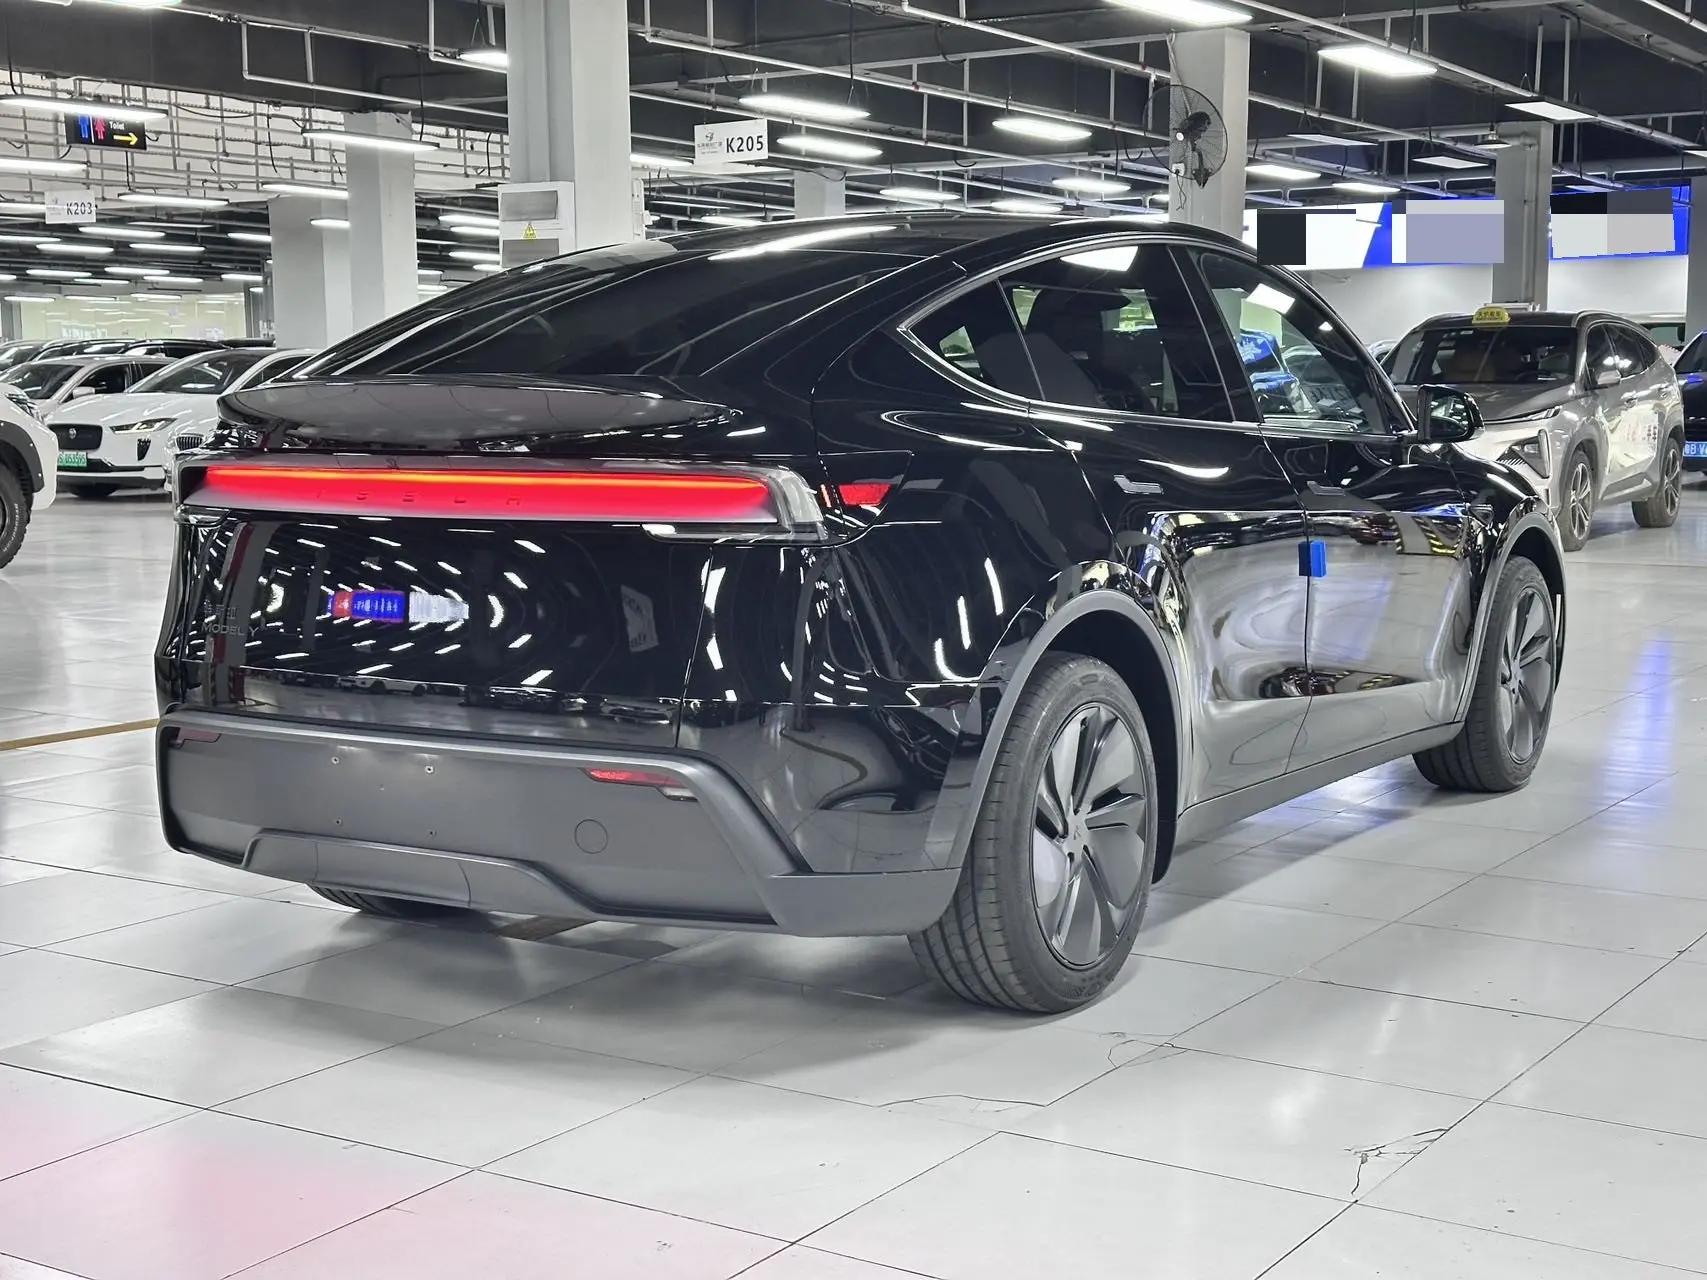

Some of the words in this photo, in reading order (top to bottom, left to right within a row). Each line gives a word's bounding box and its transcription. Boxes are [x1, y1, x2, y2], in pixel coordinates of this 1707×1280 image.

[726, 135, 764, 153] K205
[66, 202, 93, 216] K203
[201, 622, 246, 636] MODEL
[249, 626, 260, 637] Y
